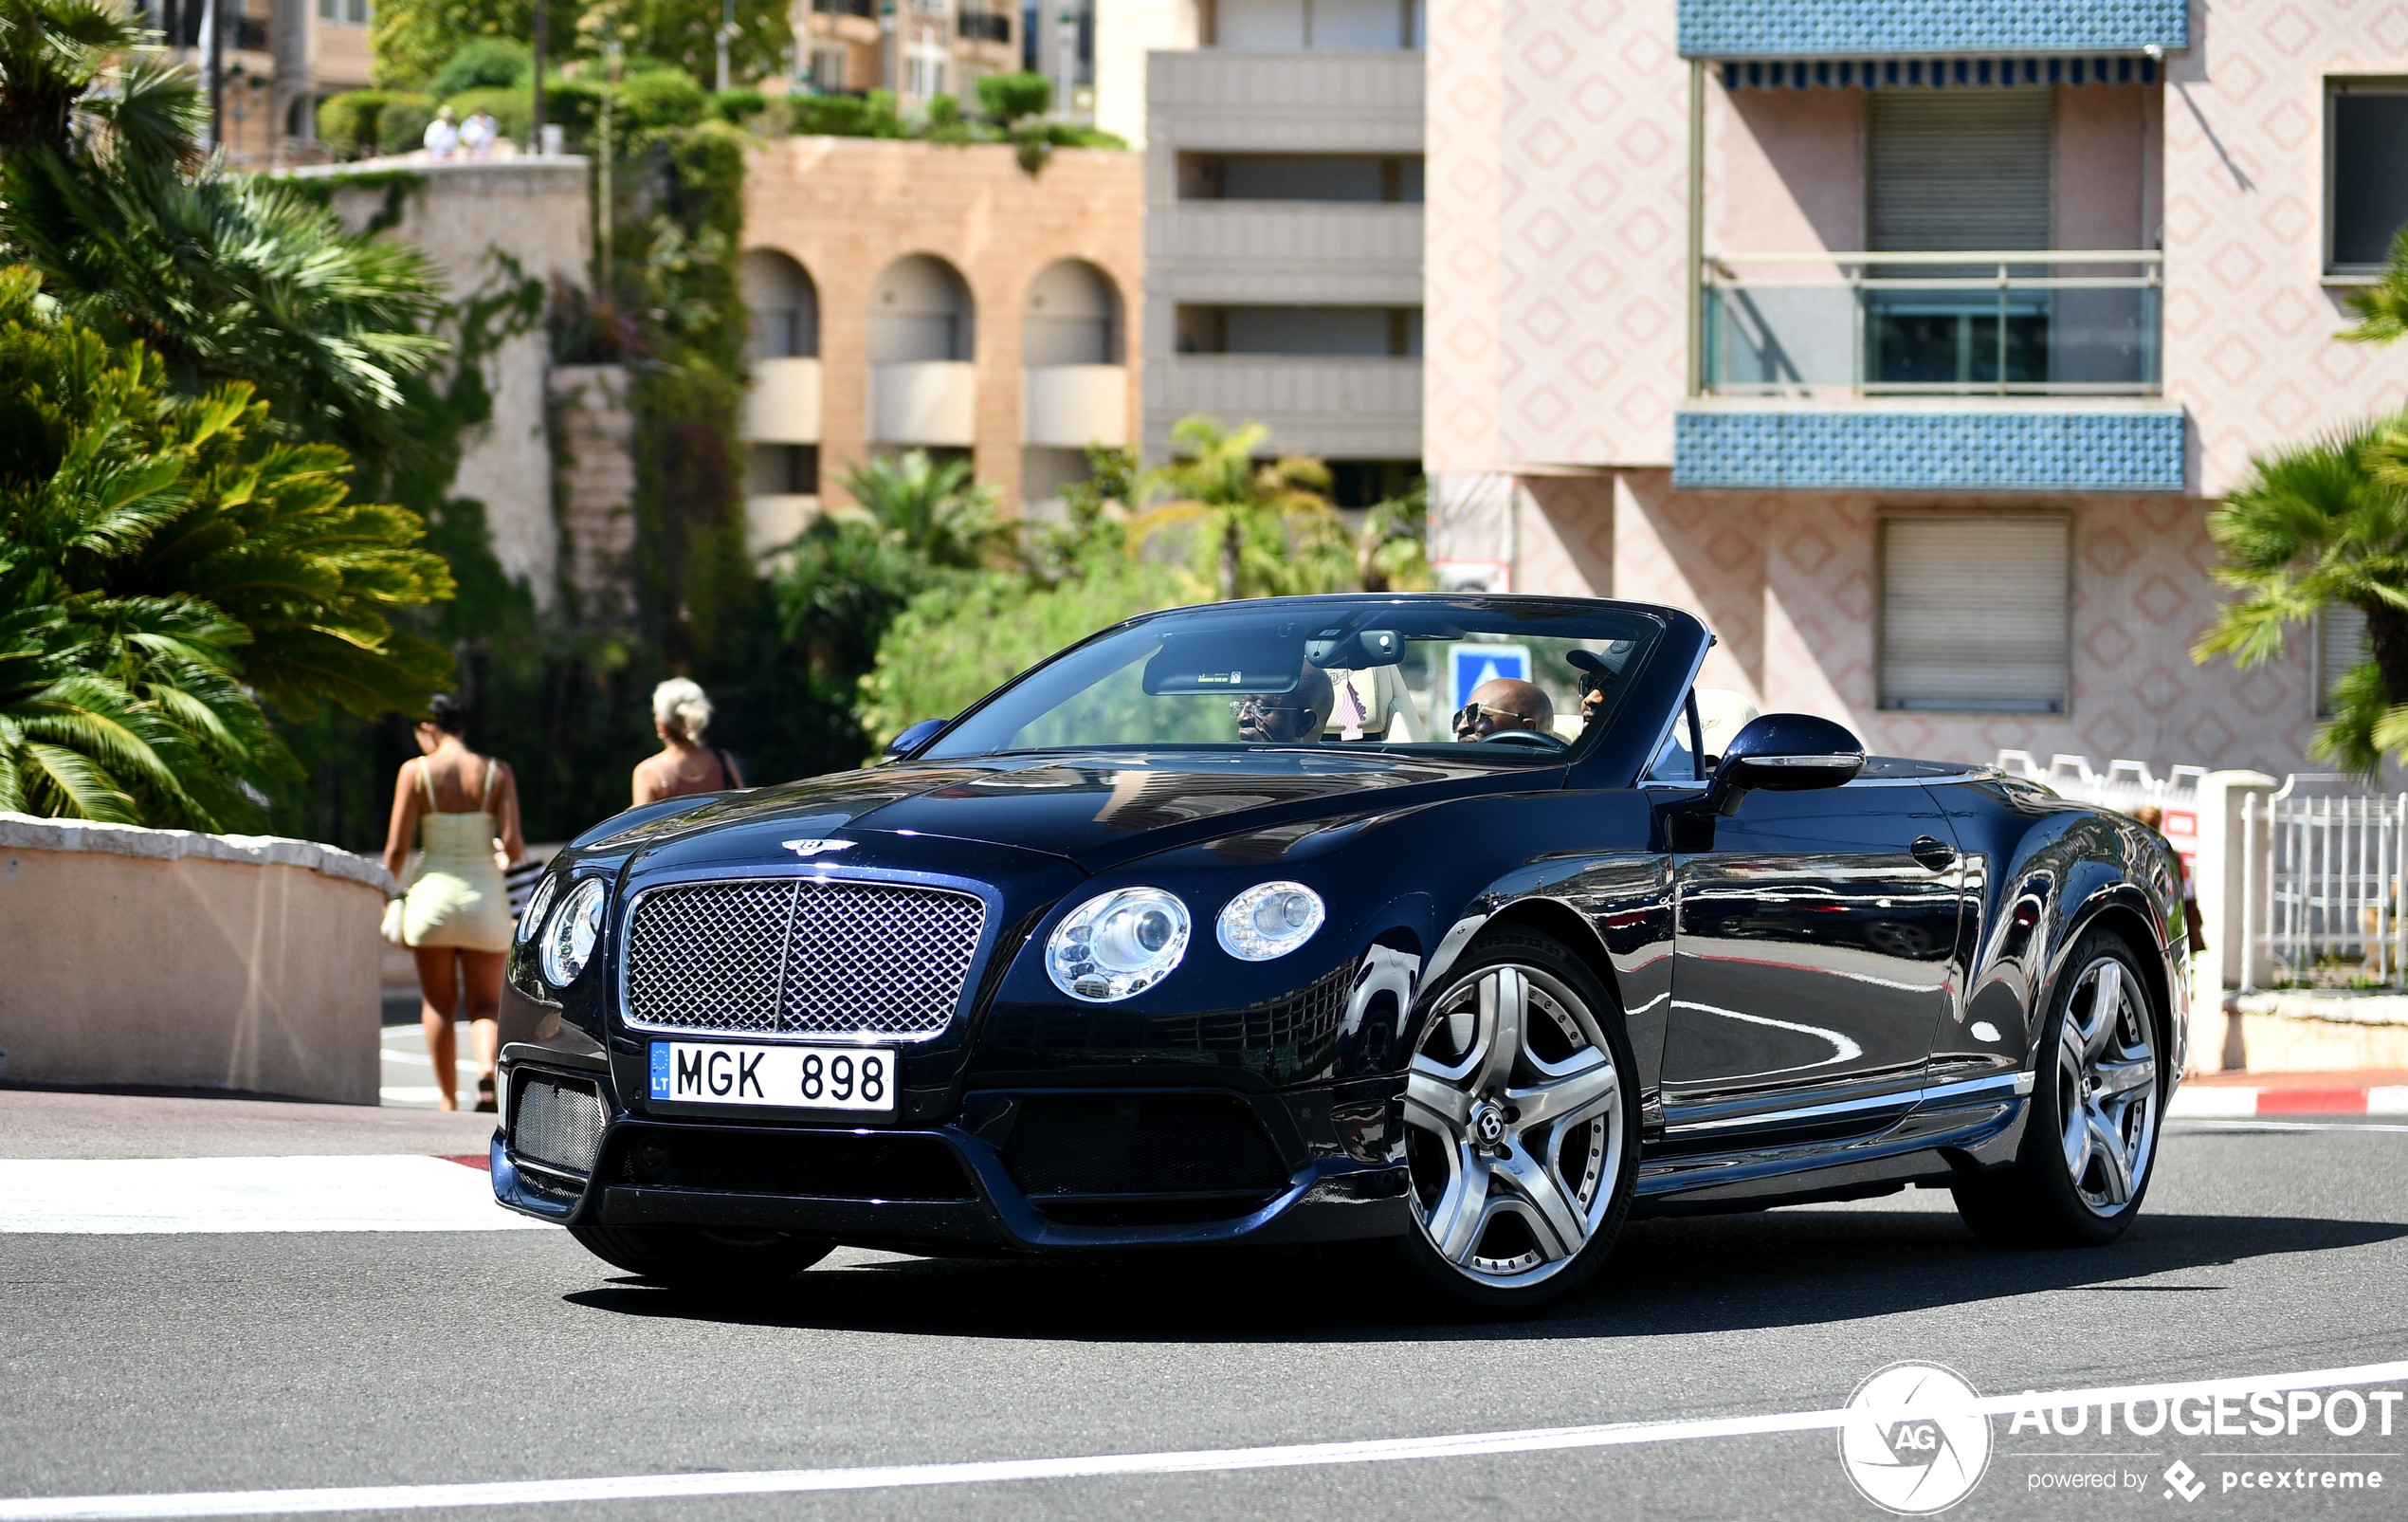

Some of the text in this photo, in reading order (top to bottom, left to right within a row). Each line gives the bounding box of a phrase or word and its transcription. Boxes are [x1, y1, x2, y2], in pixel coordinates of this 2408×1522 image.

[651, 1077, 669, 1091] LT
[677, 1049, 884, 1102] MGK 898
[1481, 1113, 1501, 1140] B
